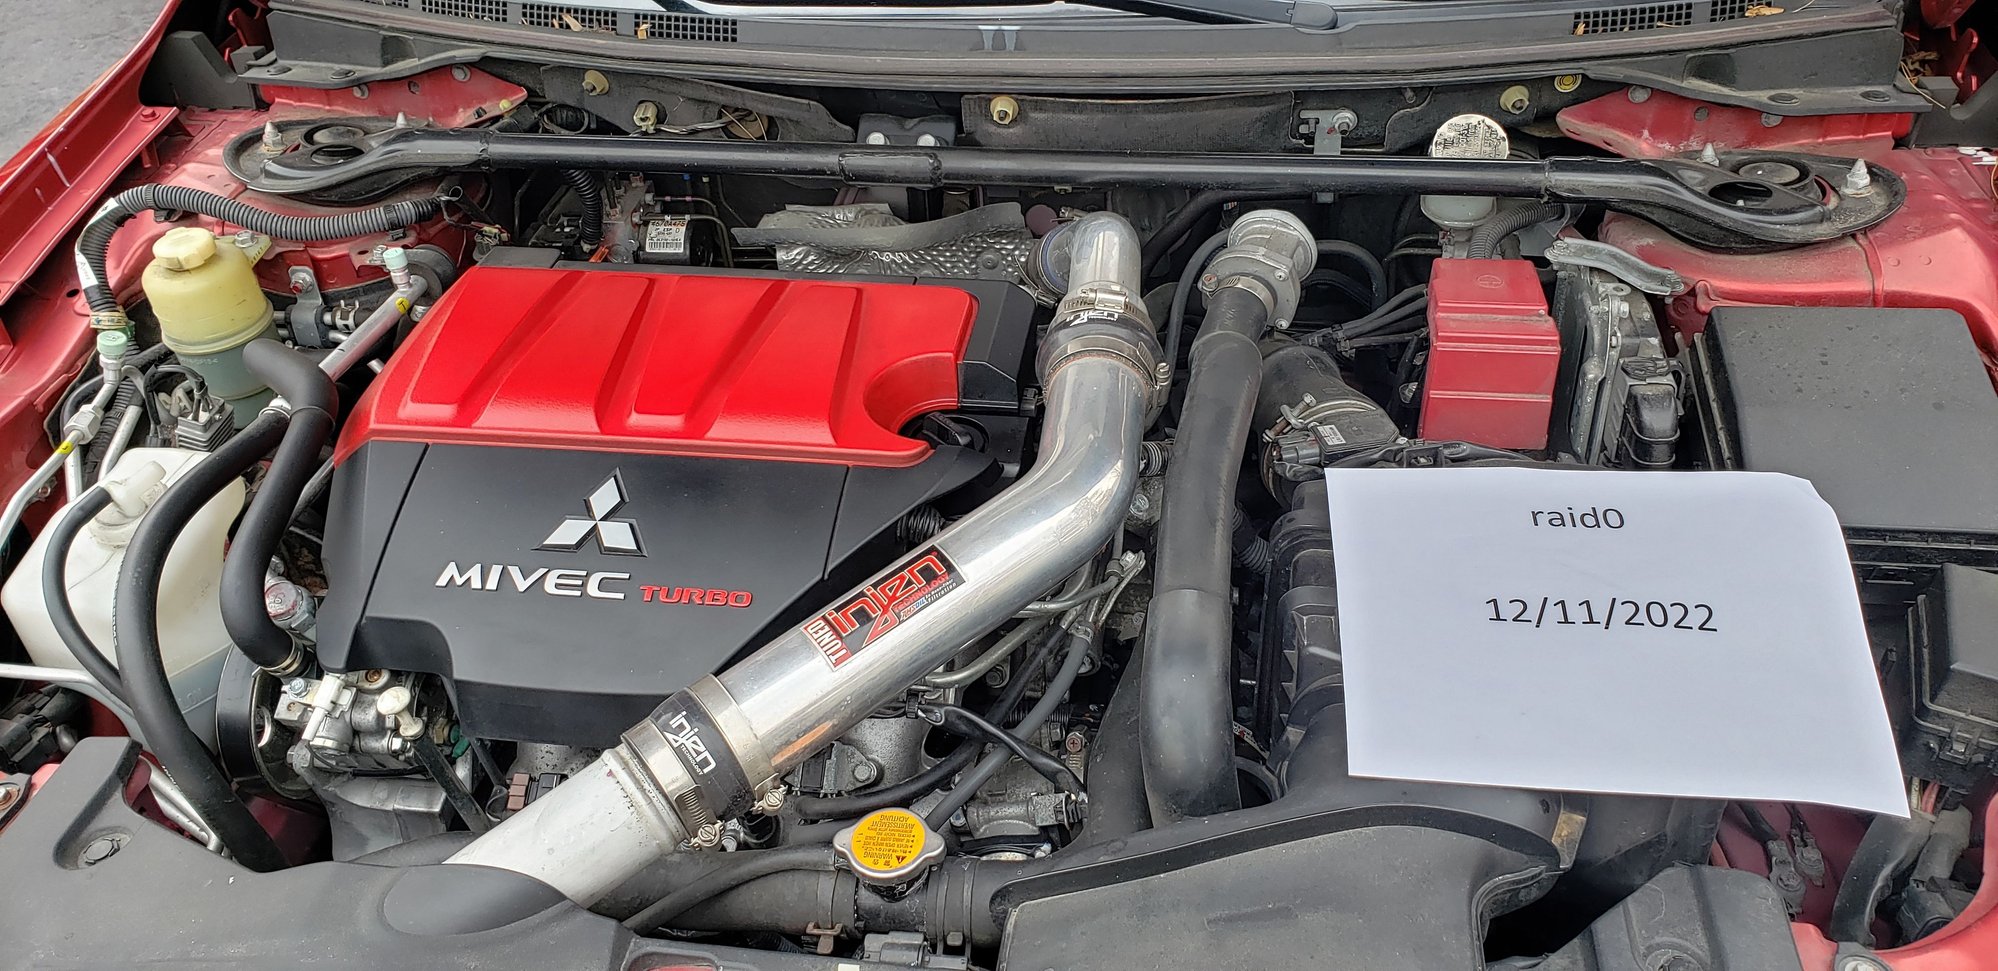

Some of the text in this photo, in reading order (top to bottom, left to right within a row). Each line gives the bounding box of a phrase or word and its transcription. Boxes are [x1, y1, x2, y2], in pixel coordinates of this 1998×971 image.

[1530, 506, 1626, 530] raid0
[435, 561, 754, 609] MIVEC TURBO
[826, 555, 947, 647] injen
[892, 572, 950, 613] TECHNOLOGY
[1485, 597, 1719, 632] 12/11/2022
[806, 619, 849, 663] TUNED
[663, 711, 717, 774] injen
[680, 744, 704, 775] TECHNOLOGY
